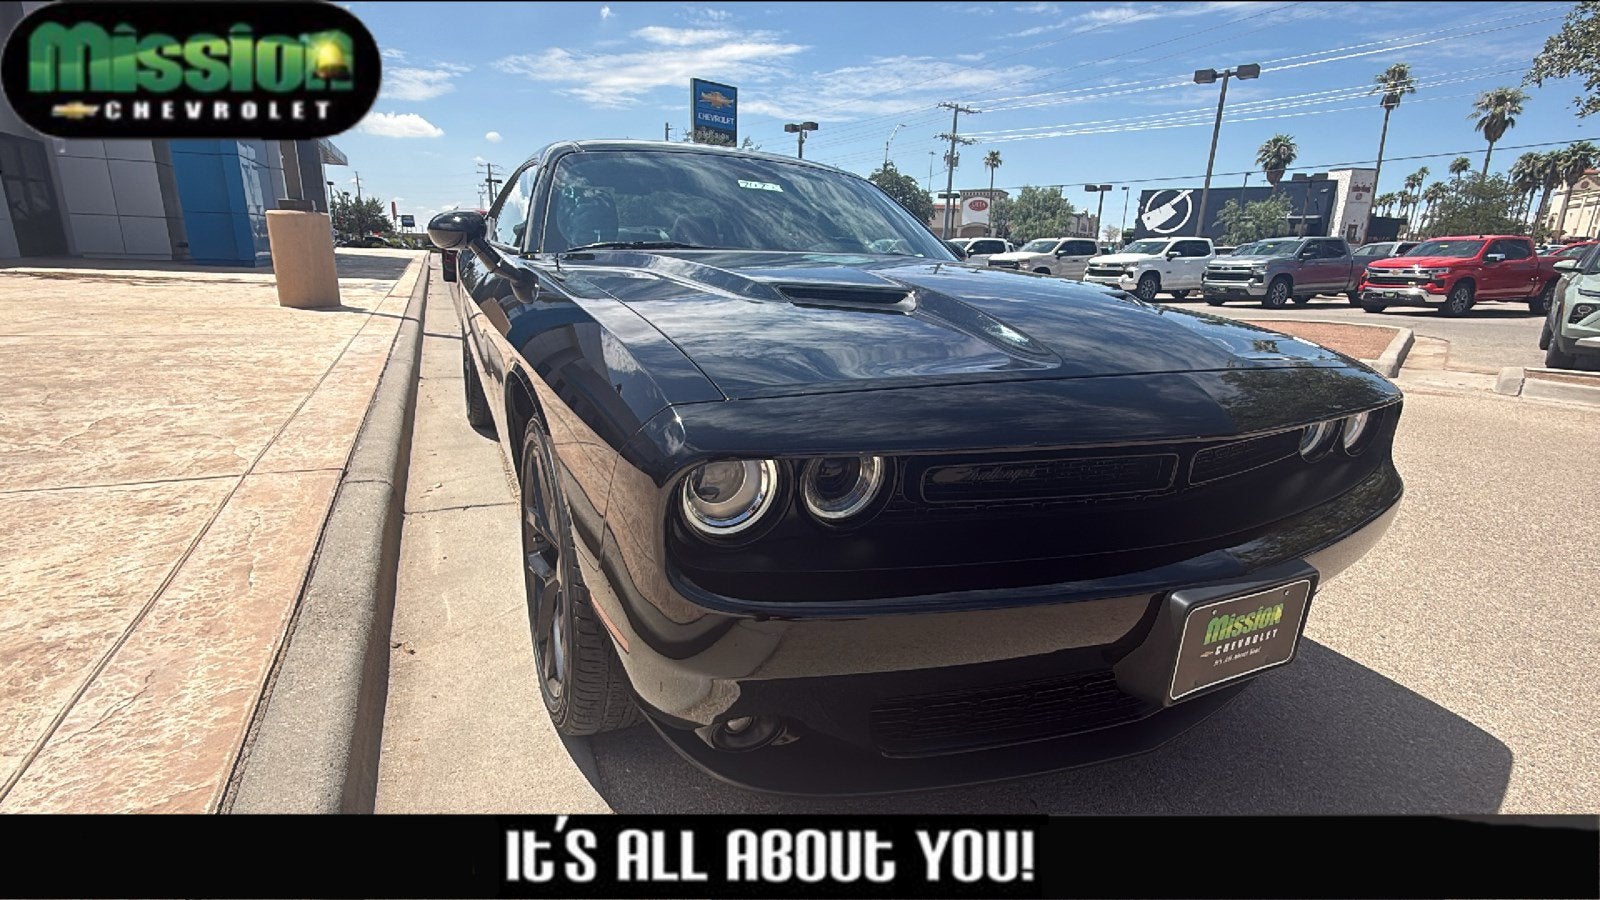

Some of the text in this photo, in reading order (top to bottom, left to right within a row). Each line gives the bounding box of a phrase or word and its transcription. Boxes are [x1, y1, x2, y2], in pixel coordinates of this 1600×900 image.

[698, 112, 735, 125] CHEVROLET
[1203, 603, 1284, 645] Mission
[1215, 629, 1278, 656] CHEVROLET
